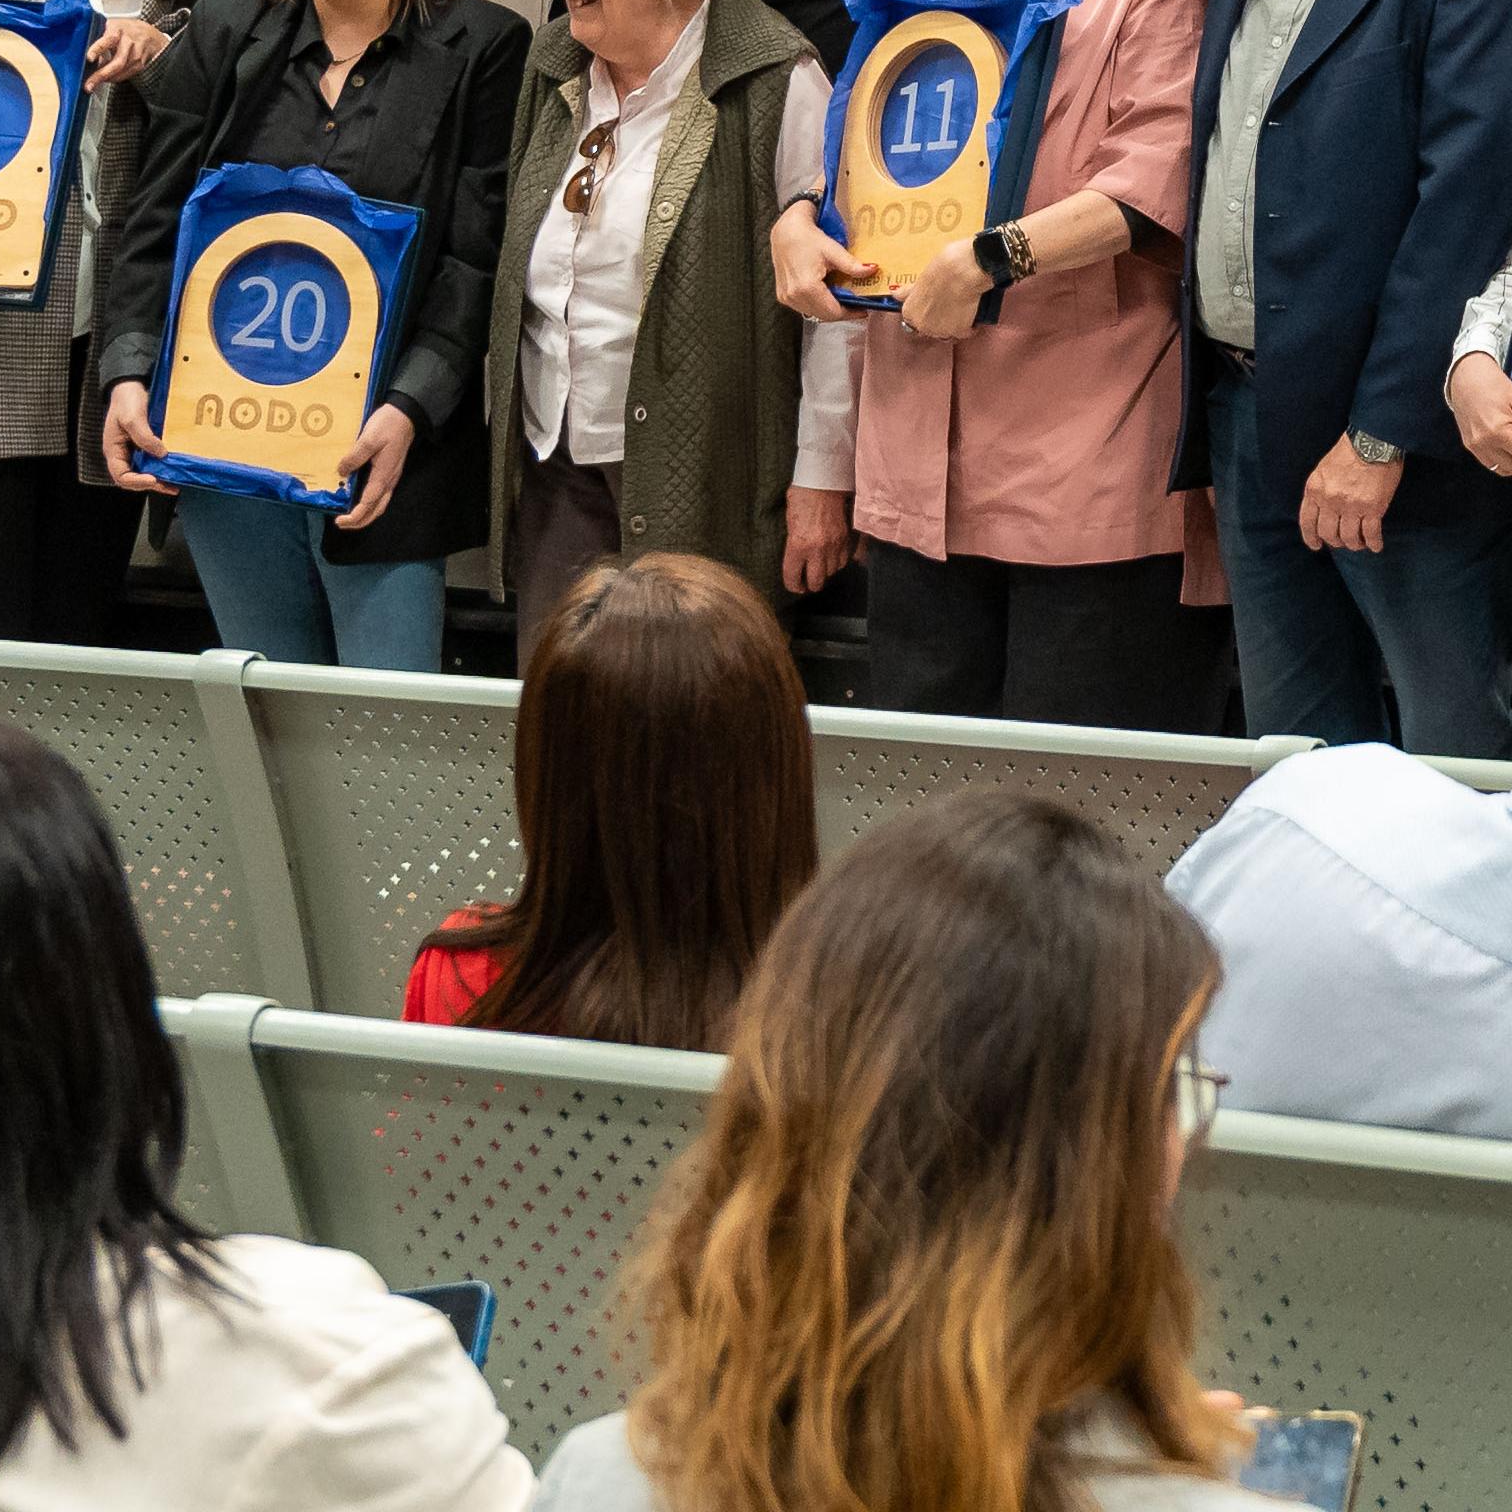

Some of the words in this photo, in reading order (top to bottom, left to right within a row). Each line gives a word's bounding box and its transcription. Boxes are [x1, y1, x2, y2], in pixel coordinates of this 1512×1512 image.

[890, 78, 959, 154] 11
[854, 200, 963, 238] NODO
[231, 276, 327, 353] 20
[194, 393, 334, 437] NODO
